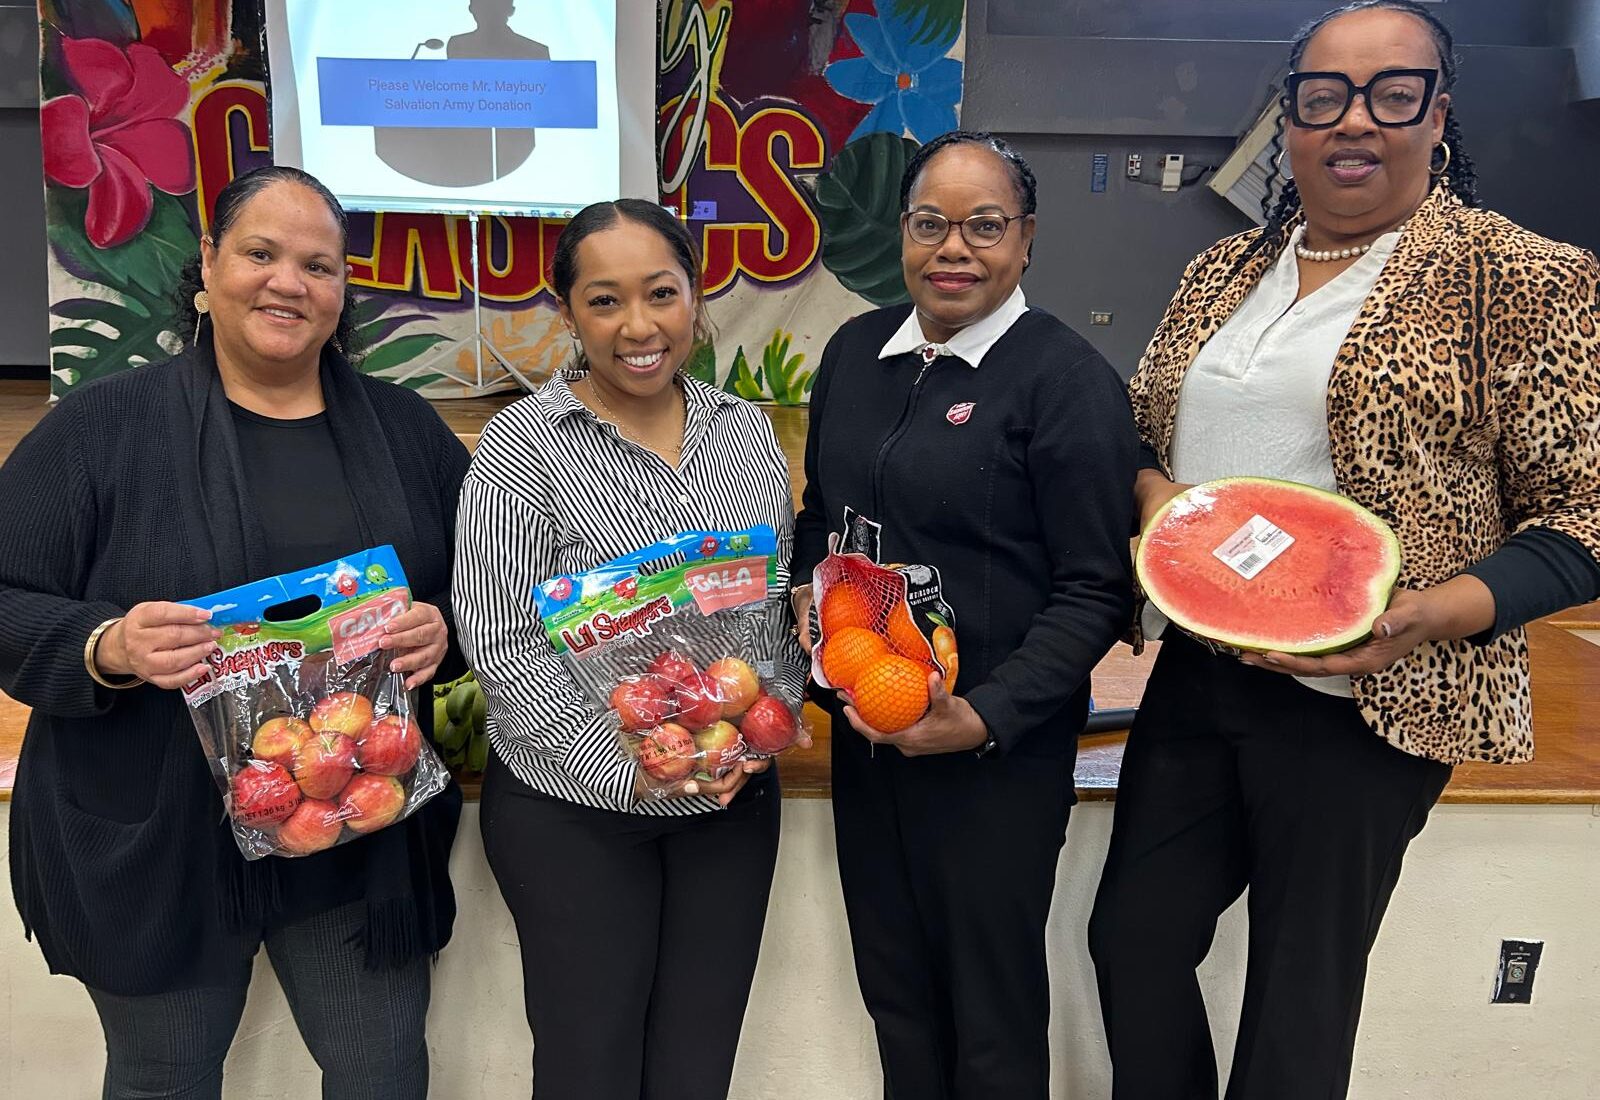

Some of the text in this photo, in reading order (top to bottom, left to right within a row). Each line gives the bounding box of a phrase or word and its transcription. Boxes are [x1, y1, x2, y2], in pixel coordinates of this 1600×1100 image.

[368, 79, 546, 95] Please Welcome Mr. Maybury
[384, 98, 532, 113] Salvation Army Donation
[693, 567, 753, 593] GALA
[340, 600, 405, 638] GALA
[562, 623, 598, 653] Lil
[592, 595, 672, 640] Snappers
[206, 641, 303, 680] Snappers
